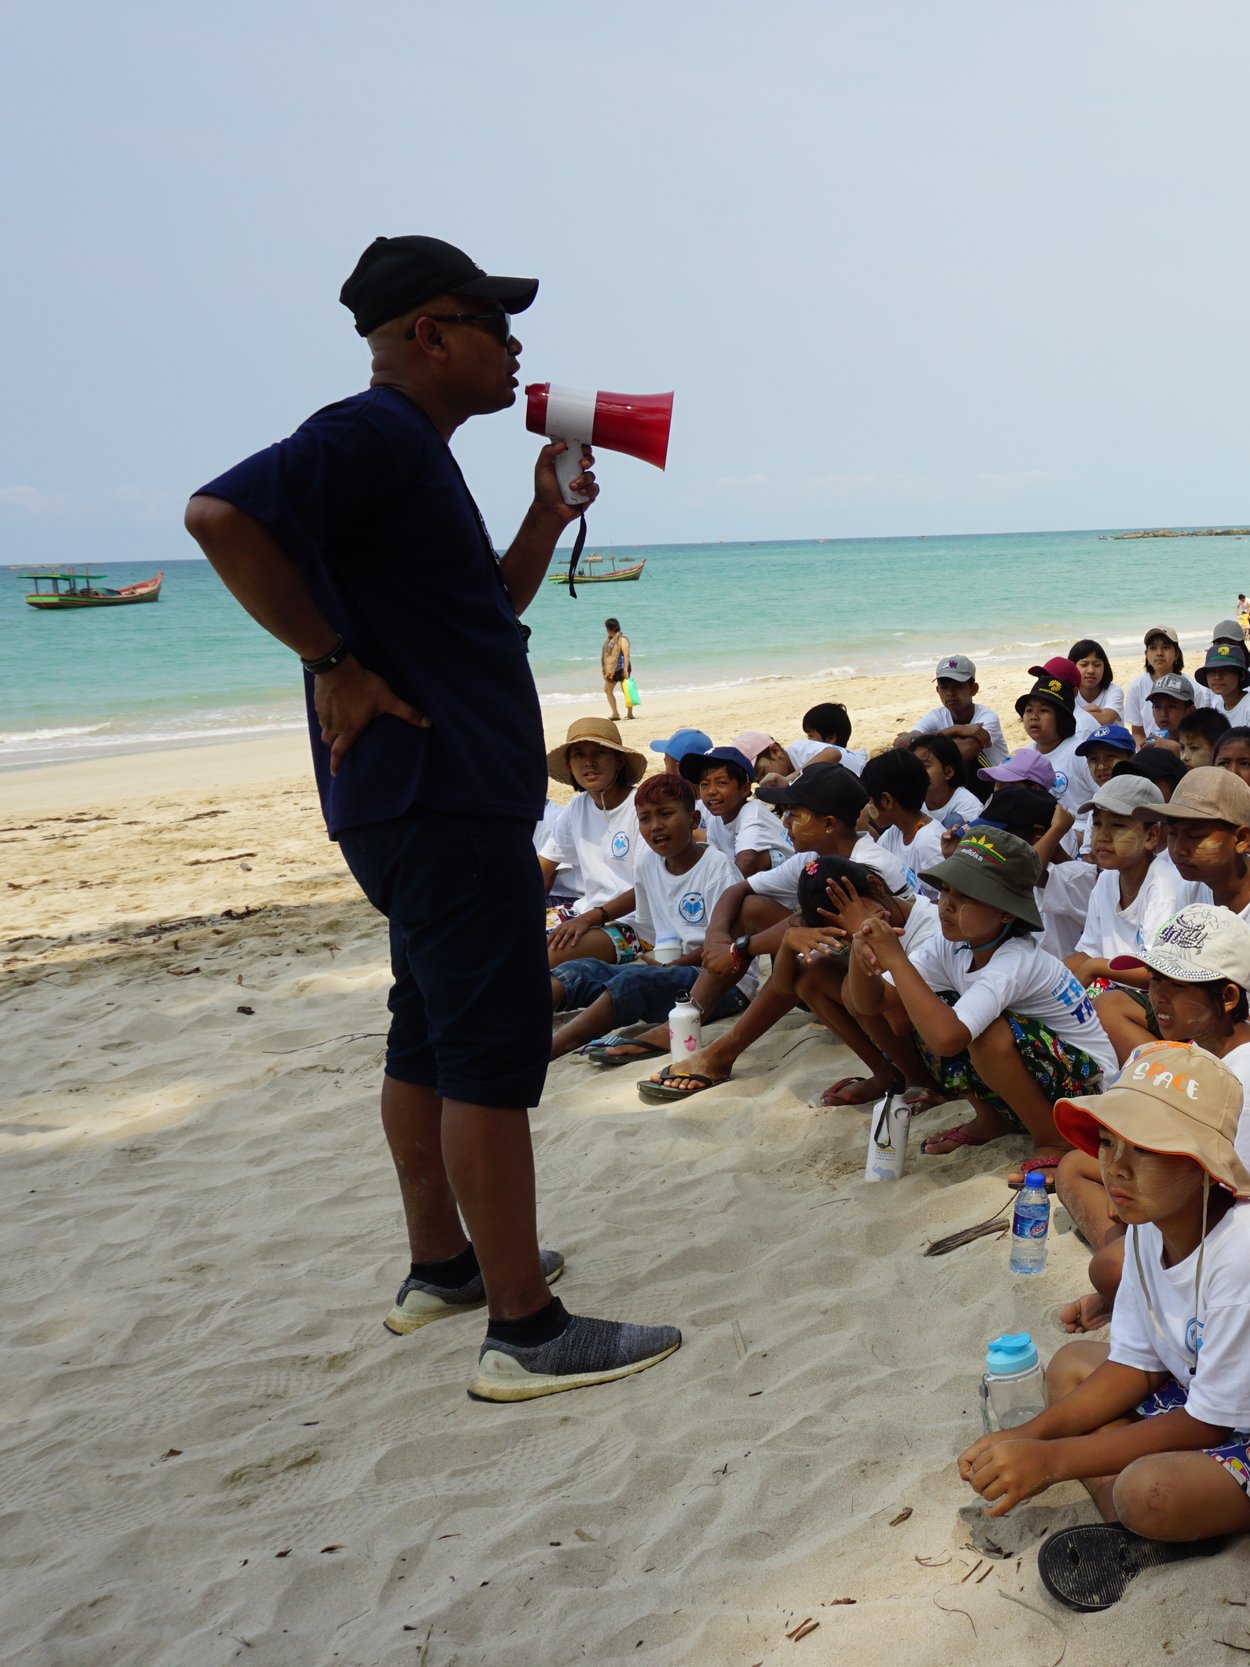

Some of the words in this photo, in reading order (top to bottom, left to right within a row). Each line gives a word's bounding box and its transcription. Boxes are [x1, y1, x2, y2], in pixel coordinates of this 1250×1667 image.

[960, 848, 984, 862] adidas
[1056, 977, 1084, 1007] TR
[1132, 1061, 1200, 1100] SPACE
